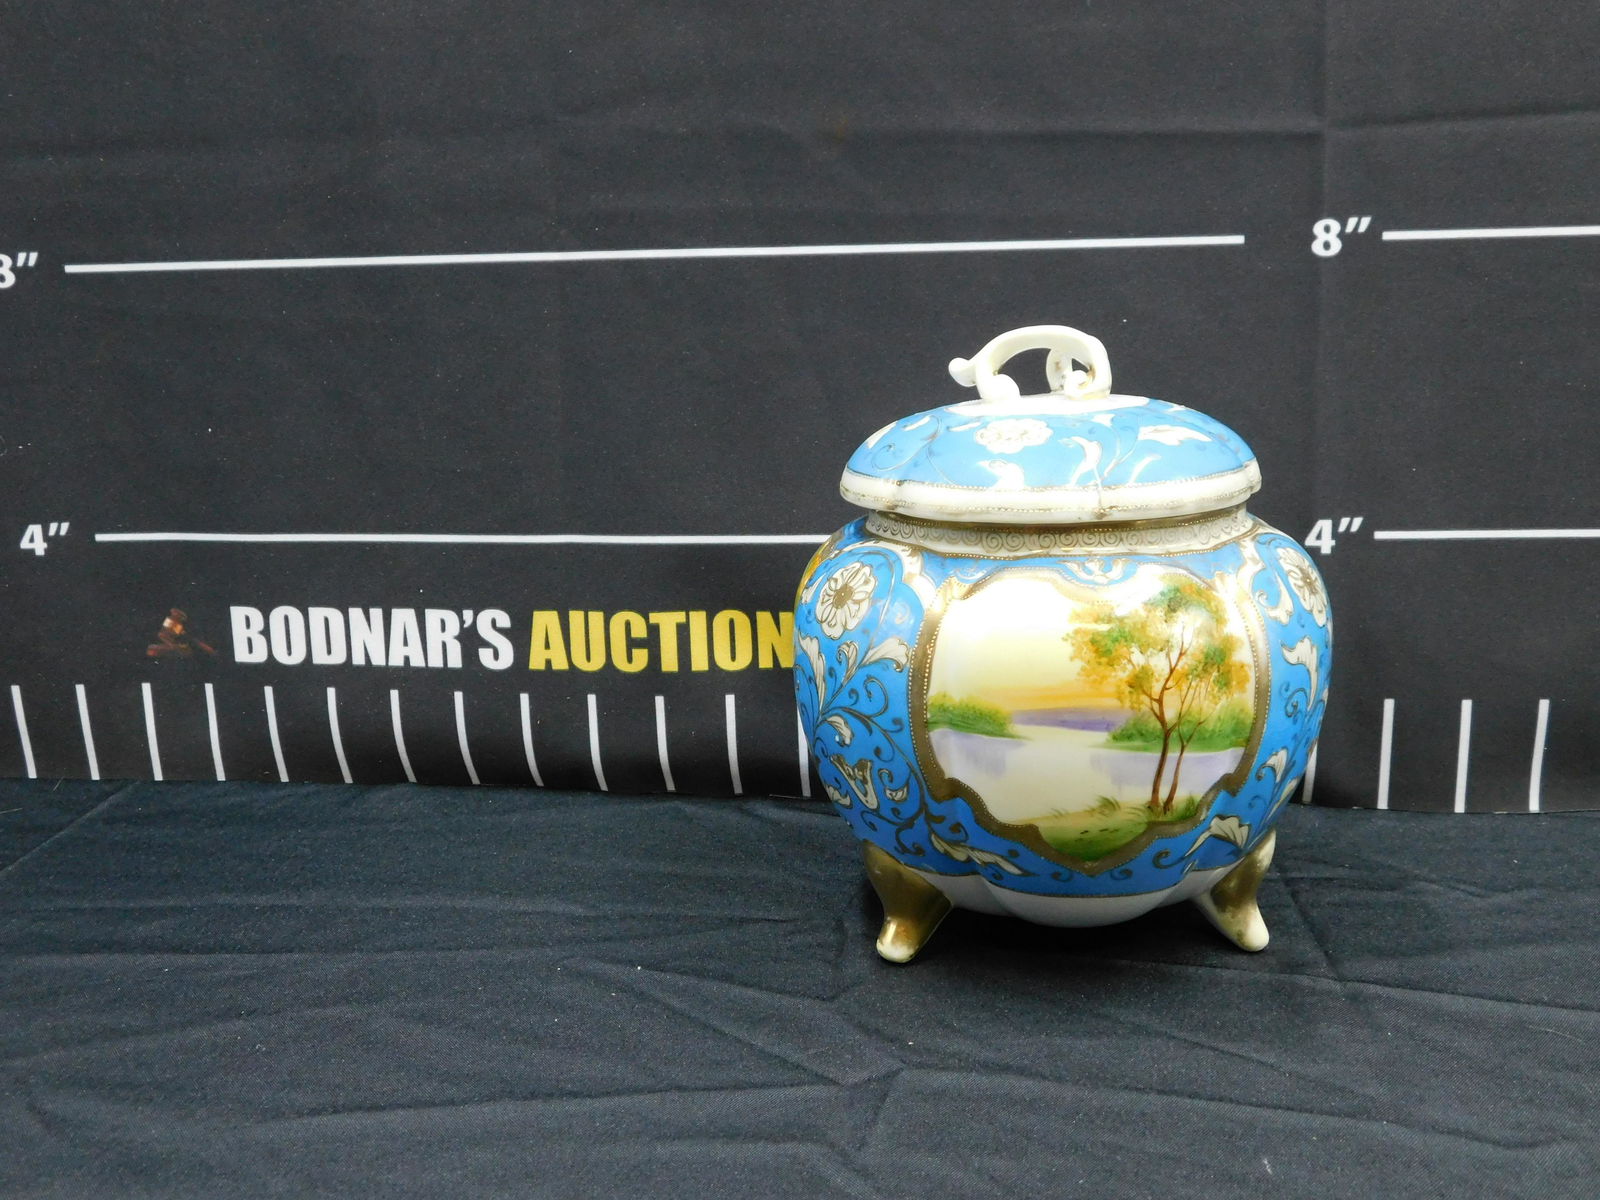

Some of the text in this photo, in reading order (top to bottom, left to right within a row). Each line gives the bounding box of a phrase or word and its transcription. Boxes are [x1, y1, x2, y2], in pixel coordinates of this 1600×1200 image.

[1310, 215, 1372, 258] 8"
[19, 521, 70, 556] 4"
[1304, 516, 1364, 555] 4"
[230, 605, 795, 673] BODNAR’S AUCTION
